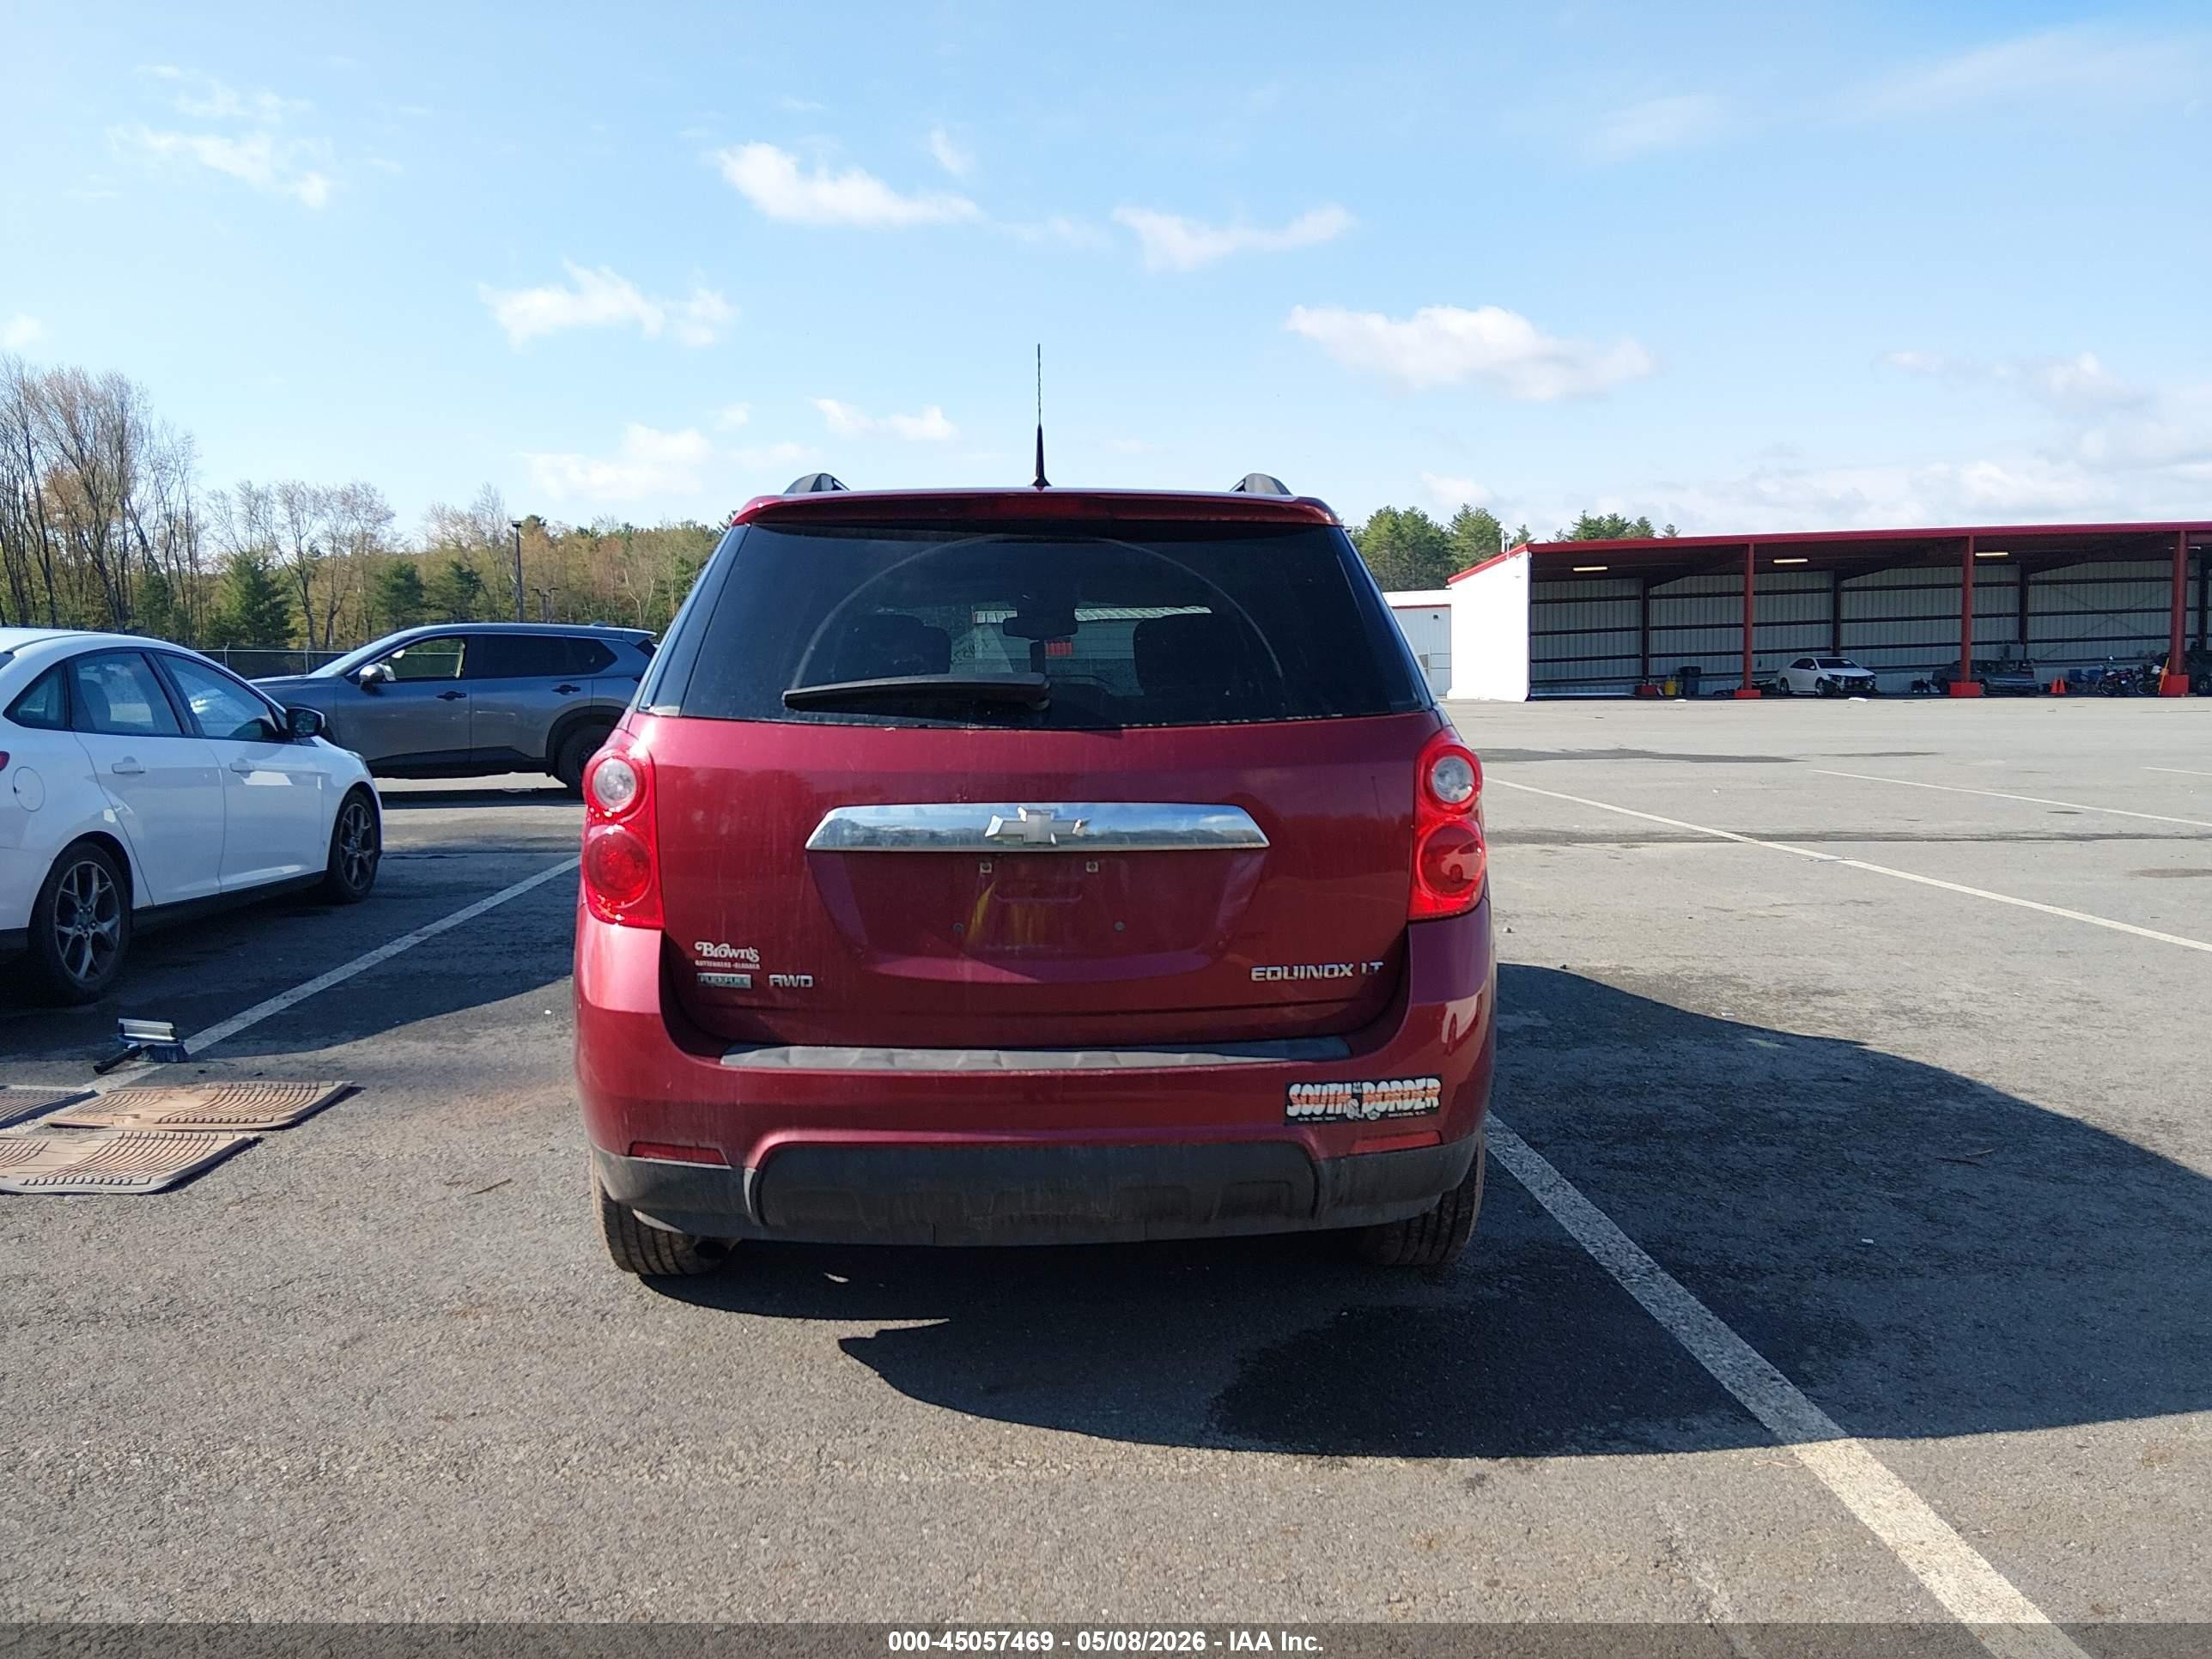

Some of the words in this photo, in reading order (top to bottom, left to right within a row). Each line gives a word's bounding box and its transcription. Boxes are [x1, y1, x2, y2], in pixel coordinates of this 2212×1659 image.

[695, 941, 760, 963] Brown's
[769, 974, 813, 988] AWD
[1251, 963, 1354, 981] EQUINOX
[1361, 962, 1384, 976] LT
[1286, 1082, 1352, 1116] SOUTH
[1361, 1078, 1443, 1114] BORDER
